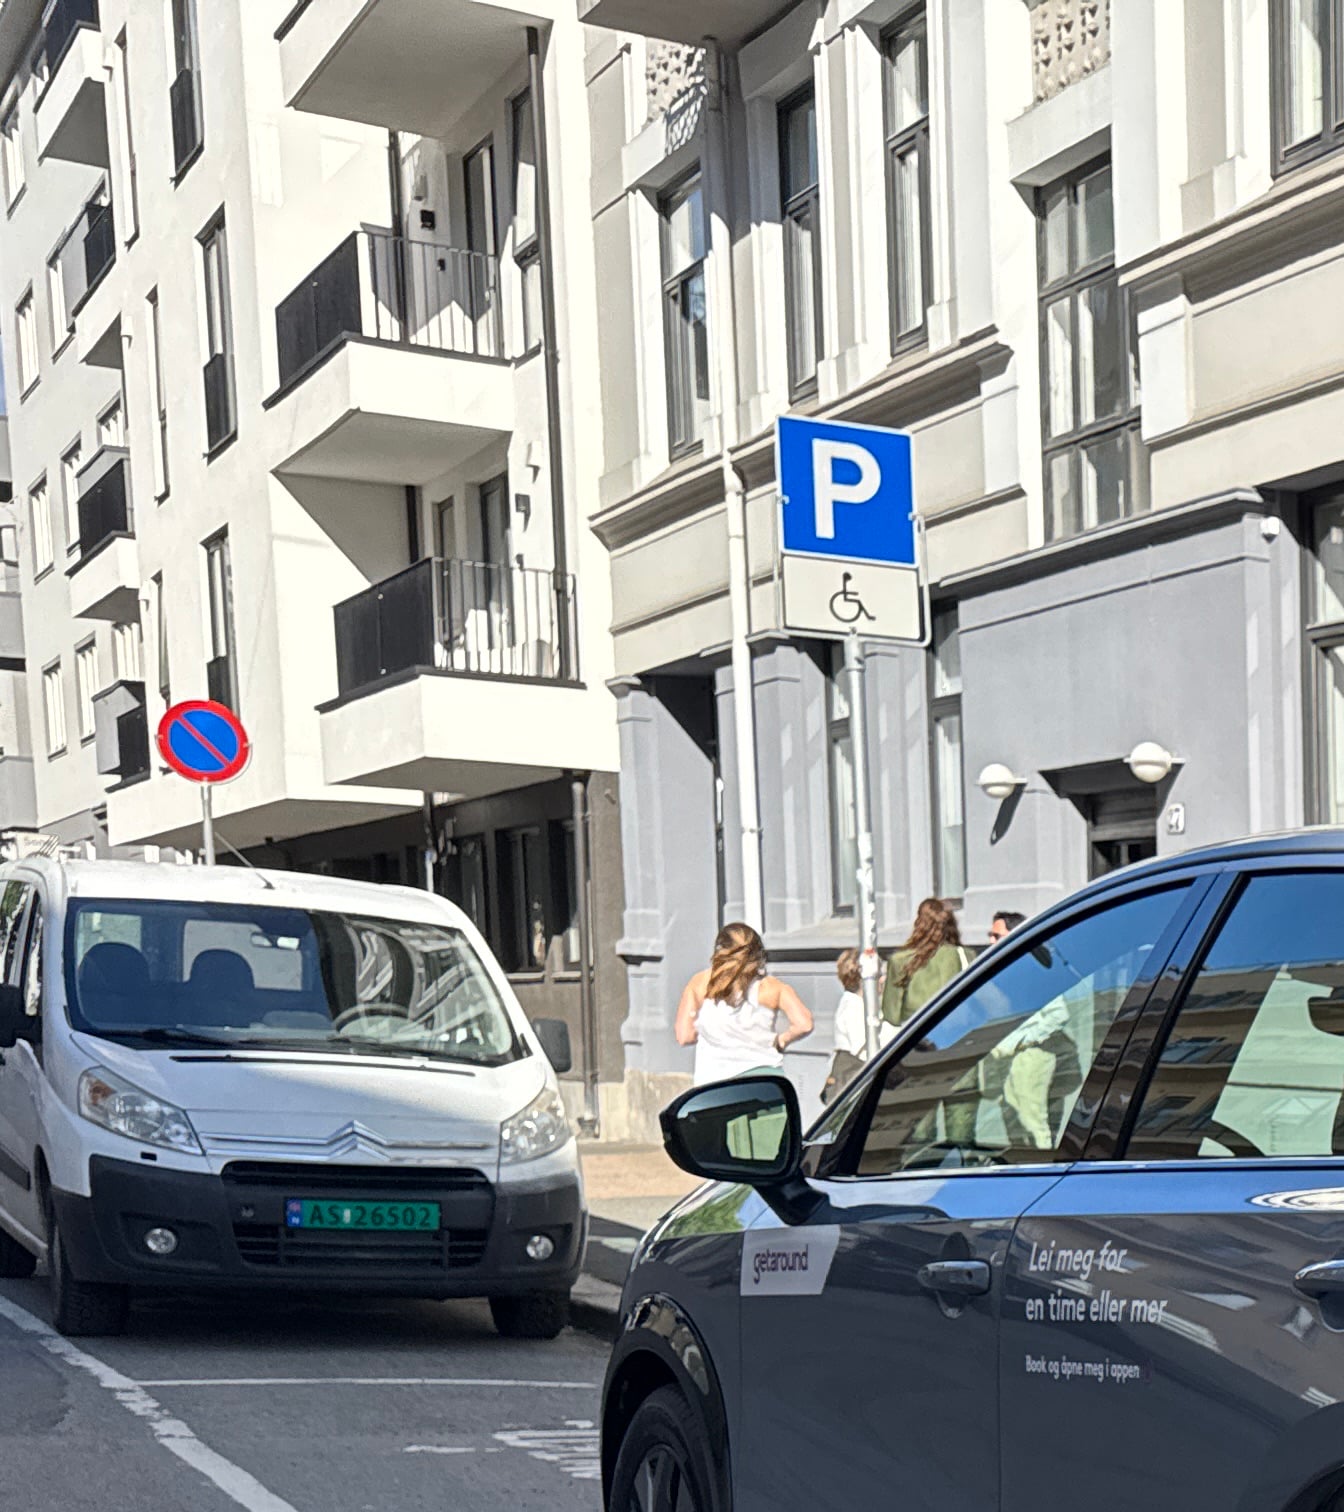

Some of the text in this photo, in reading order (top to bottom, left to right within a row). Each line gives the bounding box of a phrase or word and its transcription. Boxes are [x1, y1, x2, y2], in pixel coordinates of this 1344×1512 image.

[811, 437, 882, 540] P
[309, 1205, 432, 1227] AS 26502
[753, 1243, 809, 1285] getaround
[1029, 1240, 1128, 1281] Lei meg for
[1026, 1288, 1168, 1323] en time eller mer
[1025, 1354, 1047, 1373] Book
[1048, 1363, 1059, 1379] og
[1061, 1355, 1083, 1380] åpne
[1084, 1363, 1103, 1382] meg
[1110, 1363, 1140, 1383] appen
